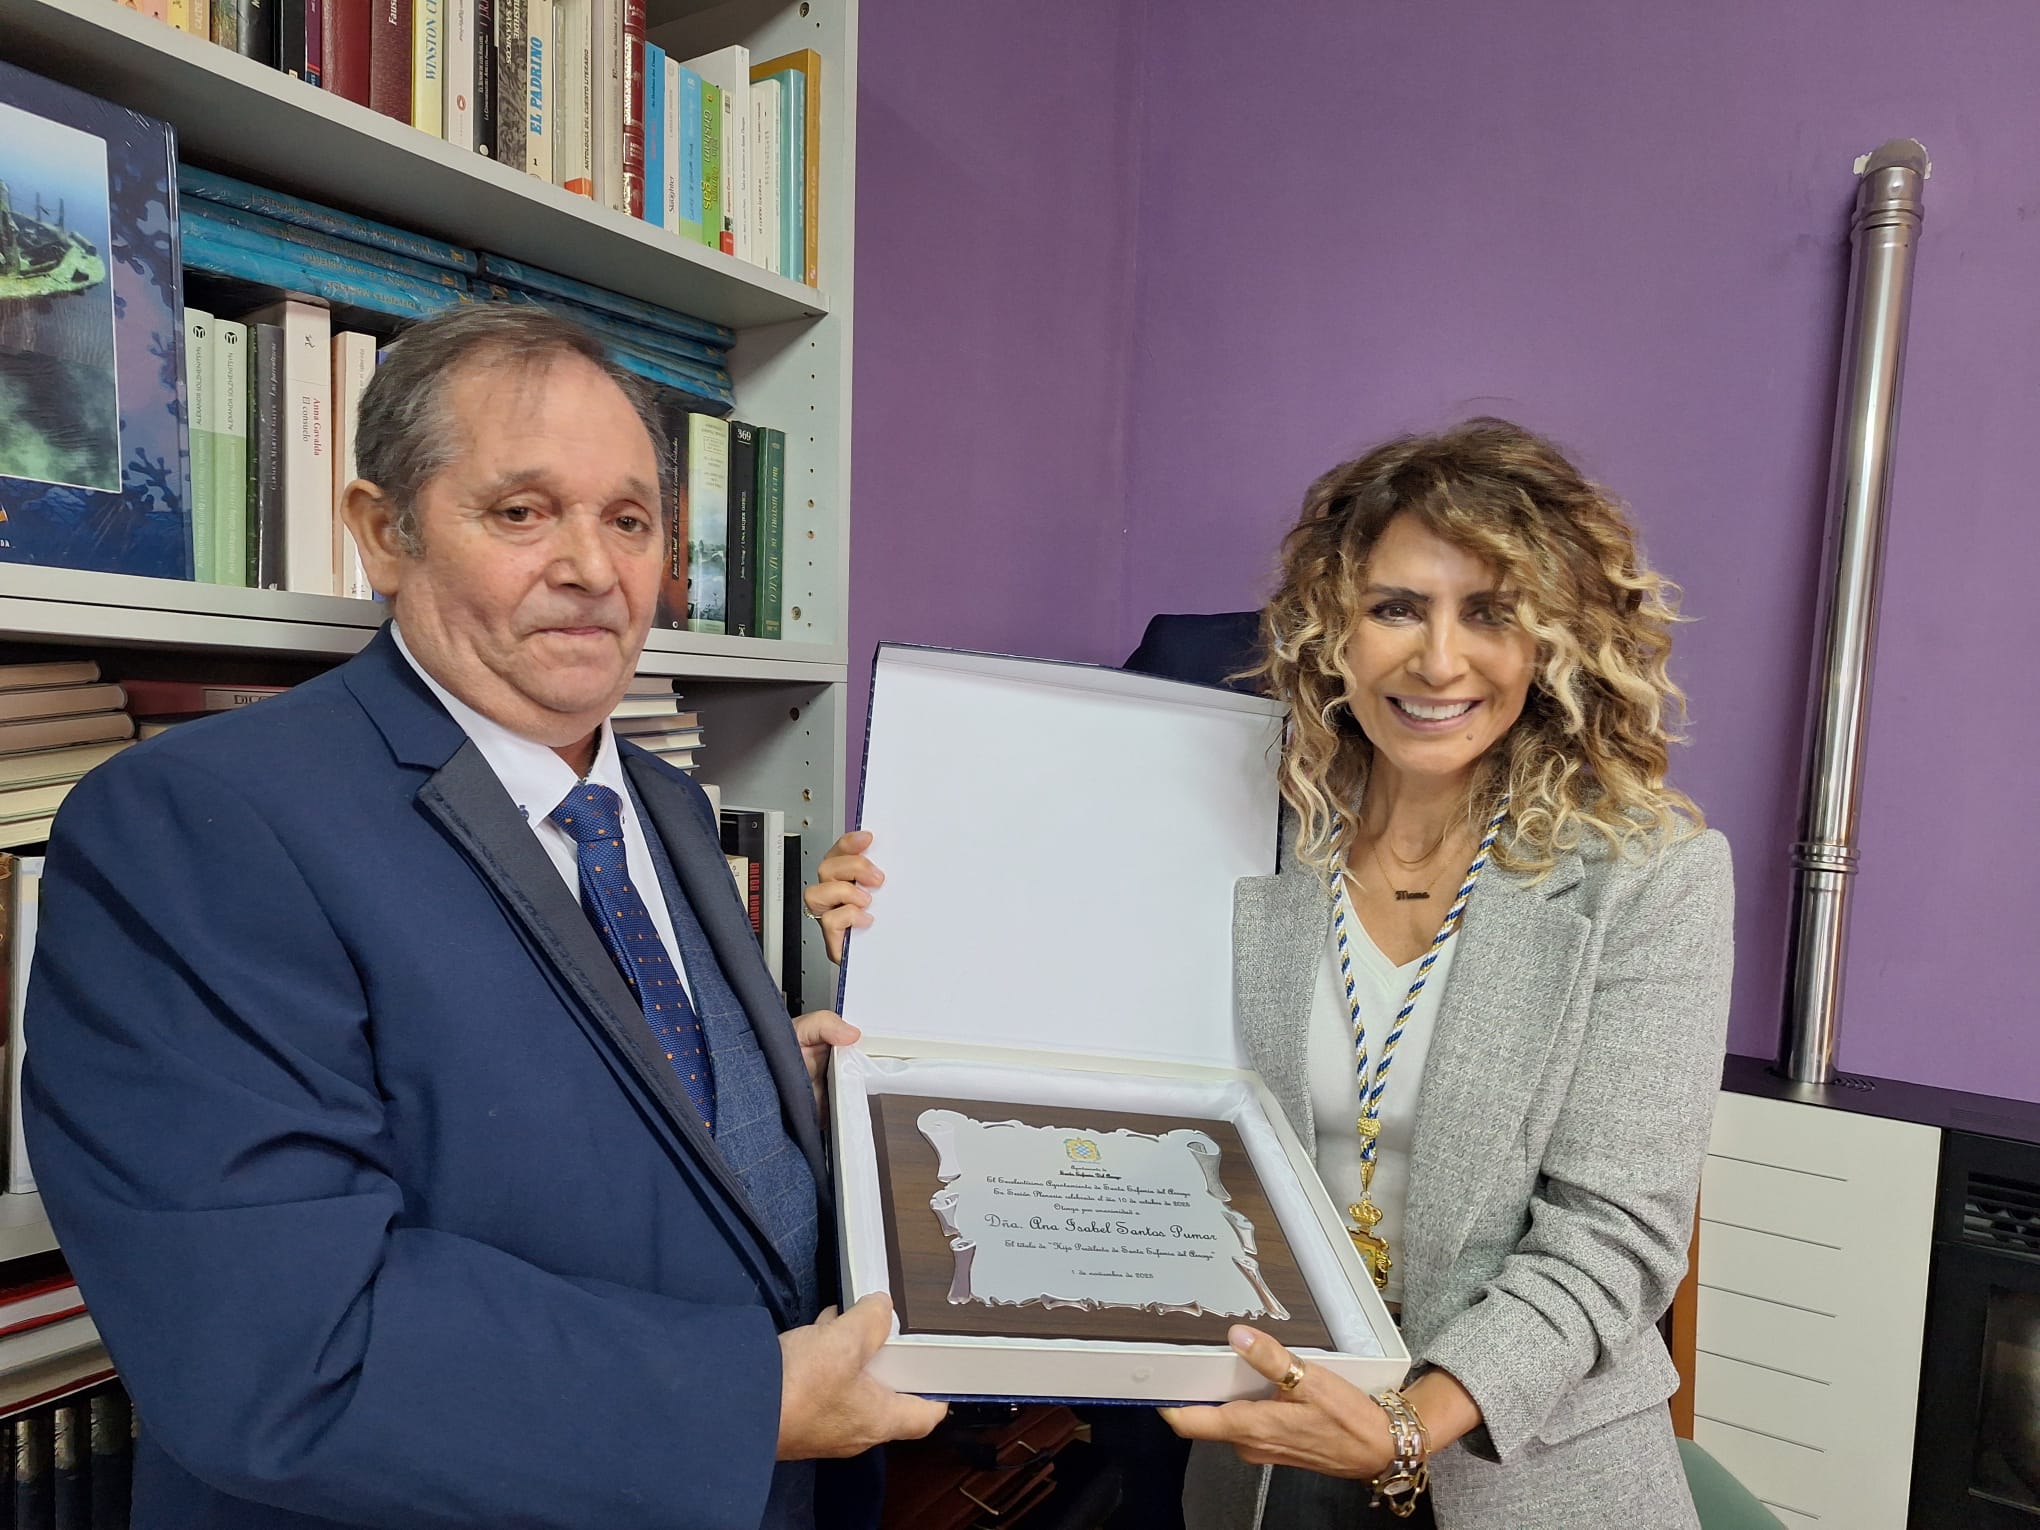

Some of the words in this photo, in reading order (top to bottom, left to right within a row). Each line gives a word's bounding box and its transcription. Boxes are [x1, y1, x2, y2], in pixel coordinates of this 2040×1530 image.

[425, 19, 437, 80] WINSTON
[530, 36, 543, 111] PADRINO
[530, 114, 543, 136] EL
[703, 110, 713, 163] Grisham
[702, 181, 713, 210] gas
[302, 395, 311, 405] El
[313, 398, 321, 421] Anna
[302, 406, 311, 442] consuelo
[736, 427, 751, 441] 369
[313, 422, 323, 456] Gavalda
[1045, 1179, 1092, 1189] Ayuntamiento
[1102, 1183, 1125, 1192] Santa
[1127, 1185, 1155, 1196] Eufemia
[1167, 1188, 1191, 1198] Arroyo
[1065, 1193, 1095, 1201] celebrada
[1139, 1198, 1162, 1206] octubre
[1053, 1202, 1080, 1213] Otorga
[984, 1213, 1024, 1229] Dña.
[1029, 1216, 1060, 1231] Ana
[1065, 1218, 1112, 1234] Isabel
[1115, 1221, 1167, 1237] Santos
[1169, 1224, 1217, 1240] Pumar
[1004, 1239, 1015, 1248] El
[1121, 1245, 1144, 1254] Santa
[1145, 1247, 1175, 1258] Eufemia
[1088, 1270, 1123, 1278] noviembre
